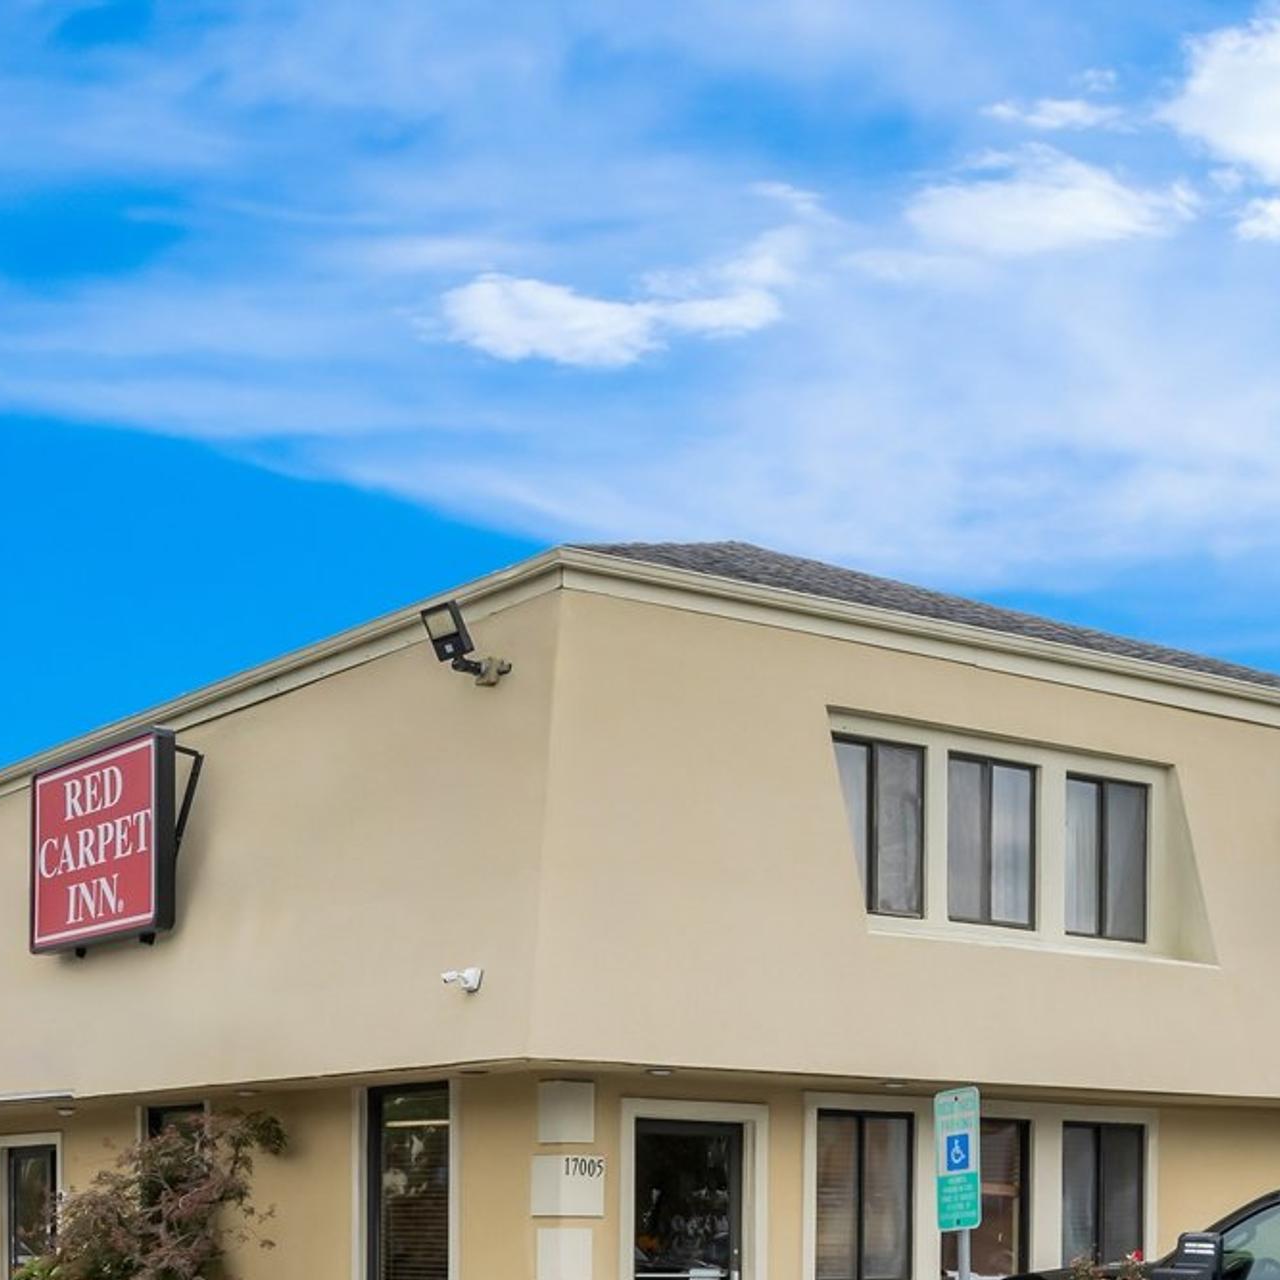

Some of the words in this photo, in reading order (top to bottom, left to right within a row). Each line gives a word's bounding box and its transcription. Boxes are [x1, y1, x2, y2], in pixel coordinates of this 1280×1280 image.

[64, 765, 123, 821] RED
[39, 808, 151, 879] CARPET
[564, 1157, 604, 1178] 17005
